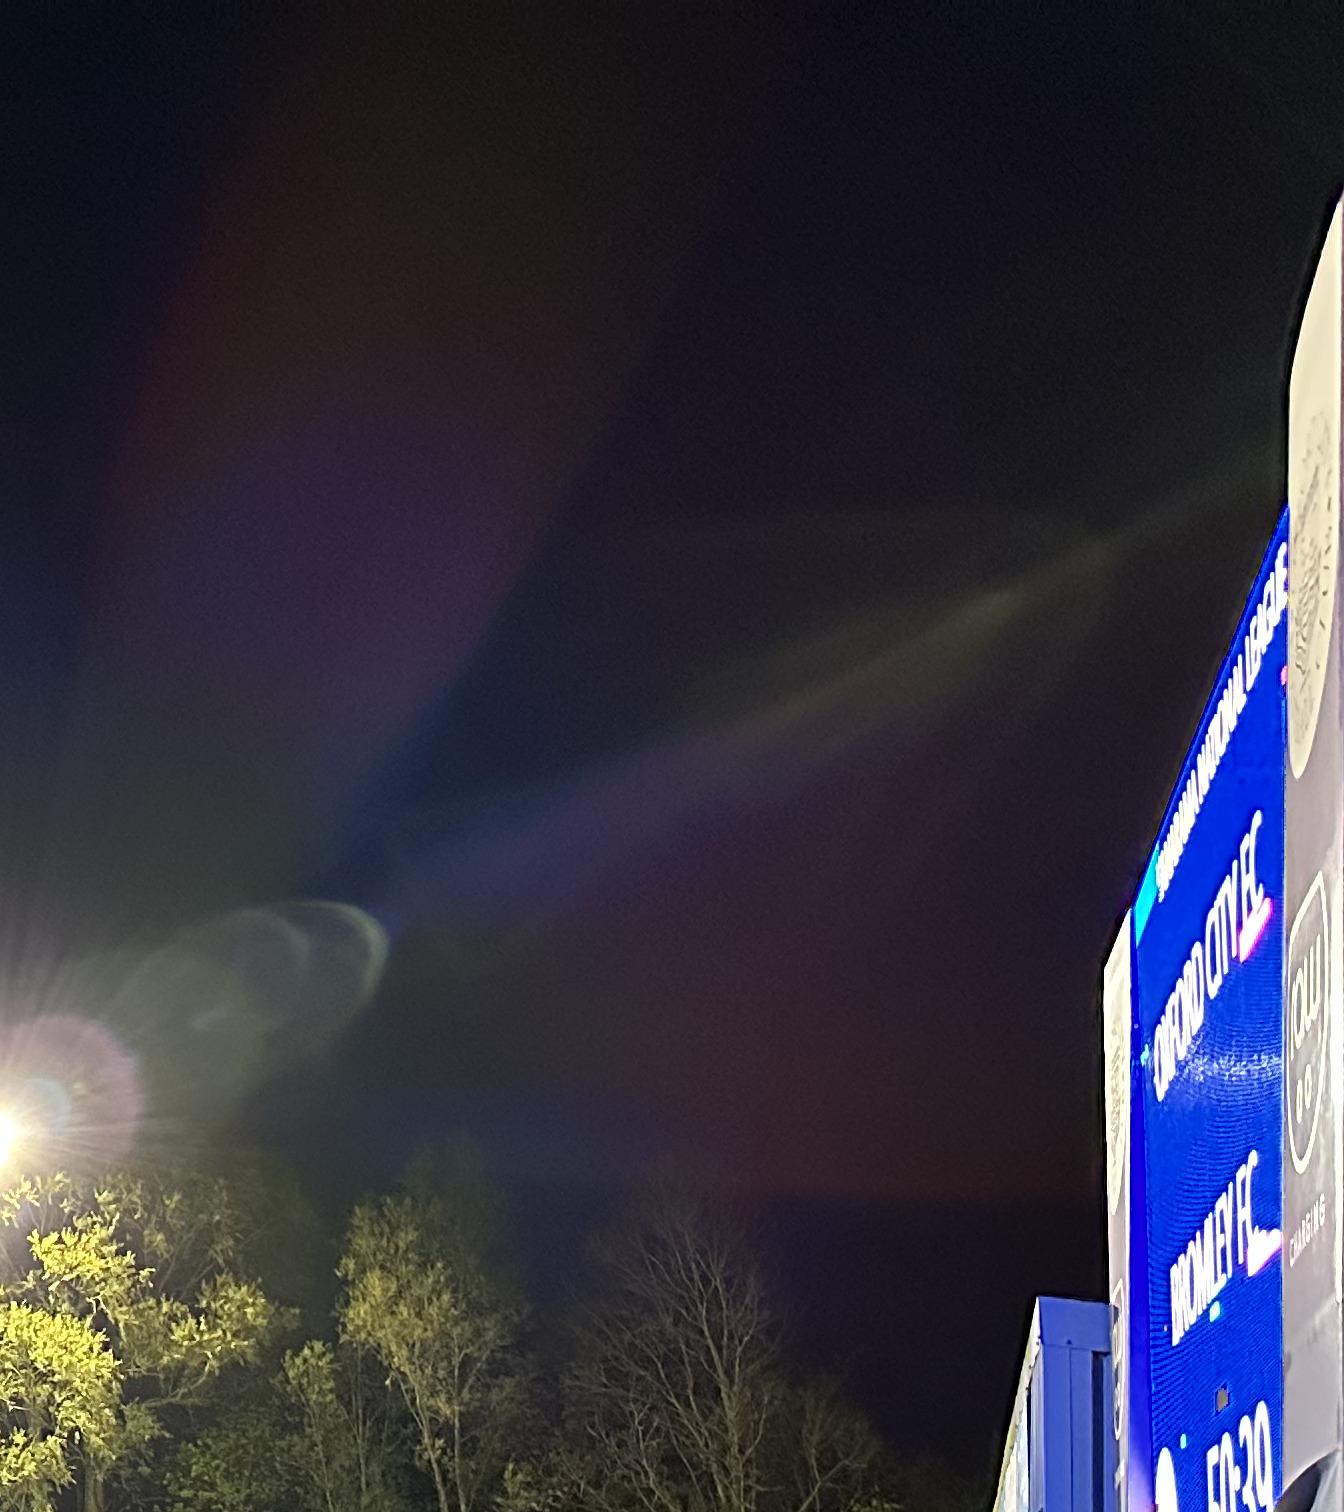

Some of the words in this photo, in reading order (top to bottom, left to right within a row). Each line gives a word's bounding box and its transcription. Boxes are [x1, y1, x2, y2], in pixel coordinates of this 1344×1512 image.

[1244, 541, 1288, 692] LEAGUE
[1154, 941, 1205, 1102] OXFORD
[1205, 860, 1239, 1000] CITY
[1240, 809, 1264, 928] FC
[1170, 1180, 1234, 1347] BROMLEY
[1235, 1149, 1259, 1266] FC
[1288, 1193, 1326, 1267] CHARGING
